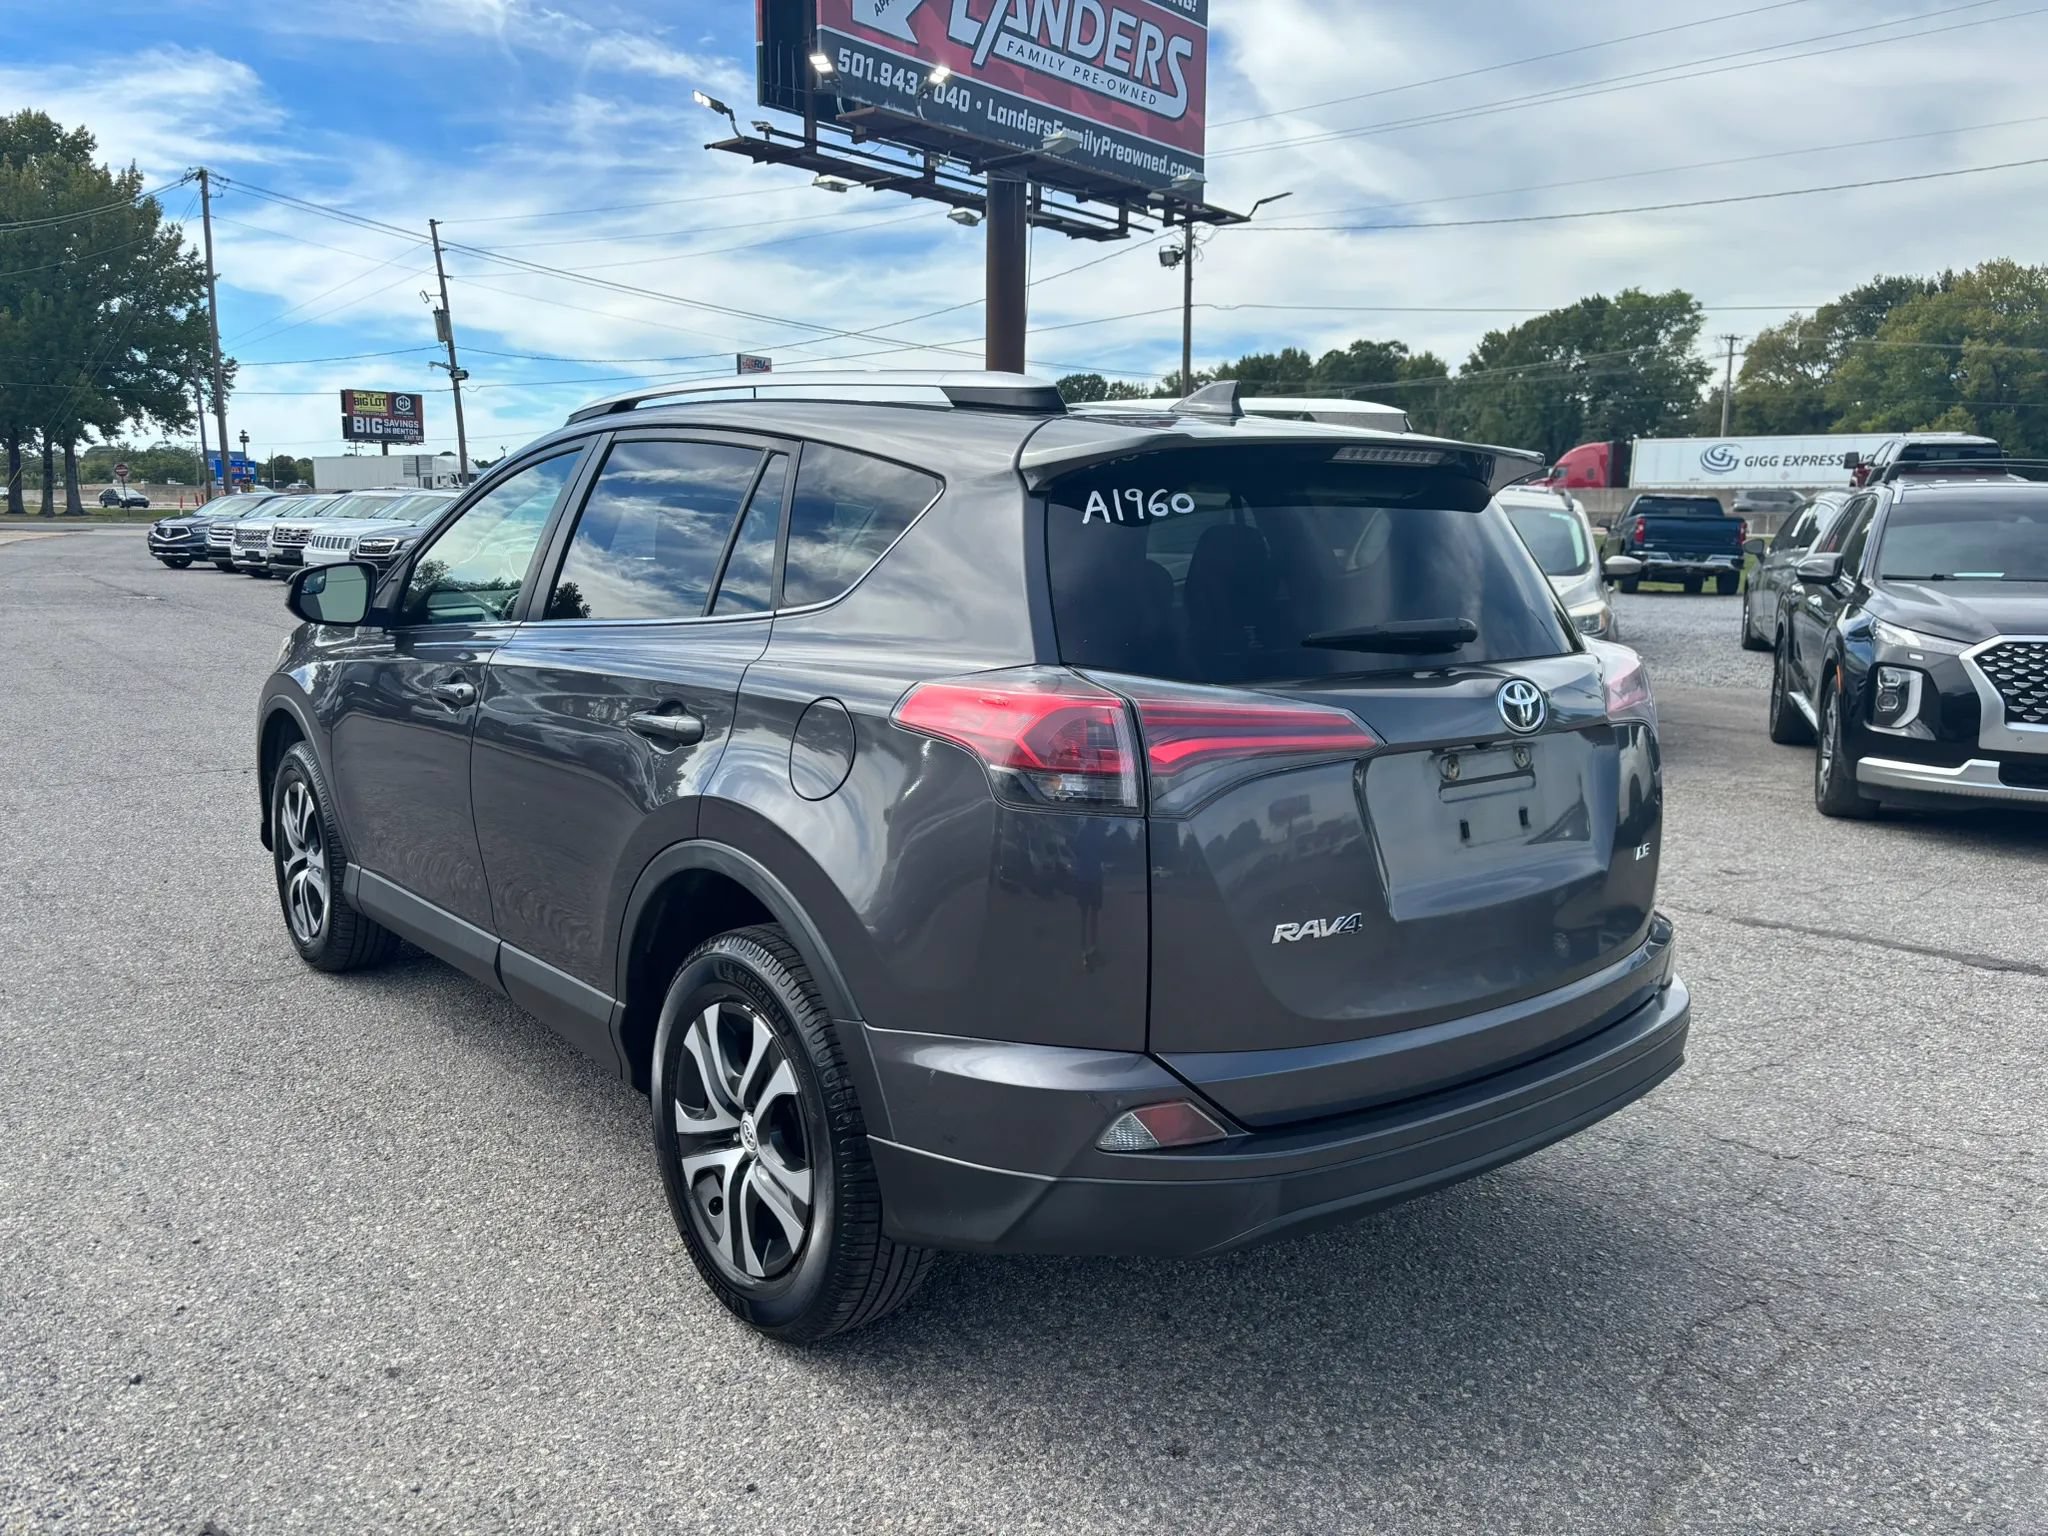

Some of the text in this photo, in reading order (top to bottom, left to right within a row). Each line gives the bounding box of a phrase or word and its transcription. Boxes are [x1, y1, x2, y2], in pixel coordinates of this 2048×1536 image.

[948, 0, 1193, 115] LANDERS
[837, 48, 970, 113] 501.943040
[1007, 40, 1157, 106] FAMILY PRE-OWNED
[353, 397, 386, 407] BIG LOT
[353, 417, 419, 434] BIG SAVINGS
[392, 427, 419, 435] BENTON
[1744, 455, 1778, 467] GIGG
[1783, 454, 1845, 467] EXPRESS
[1082, 488, 1195, 524] A1960
[1634, 842, 1651, 861] LE
[1271, 912, 1363, 944] RAV4
